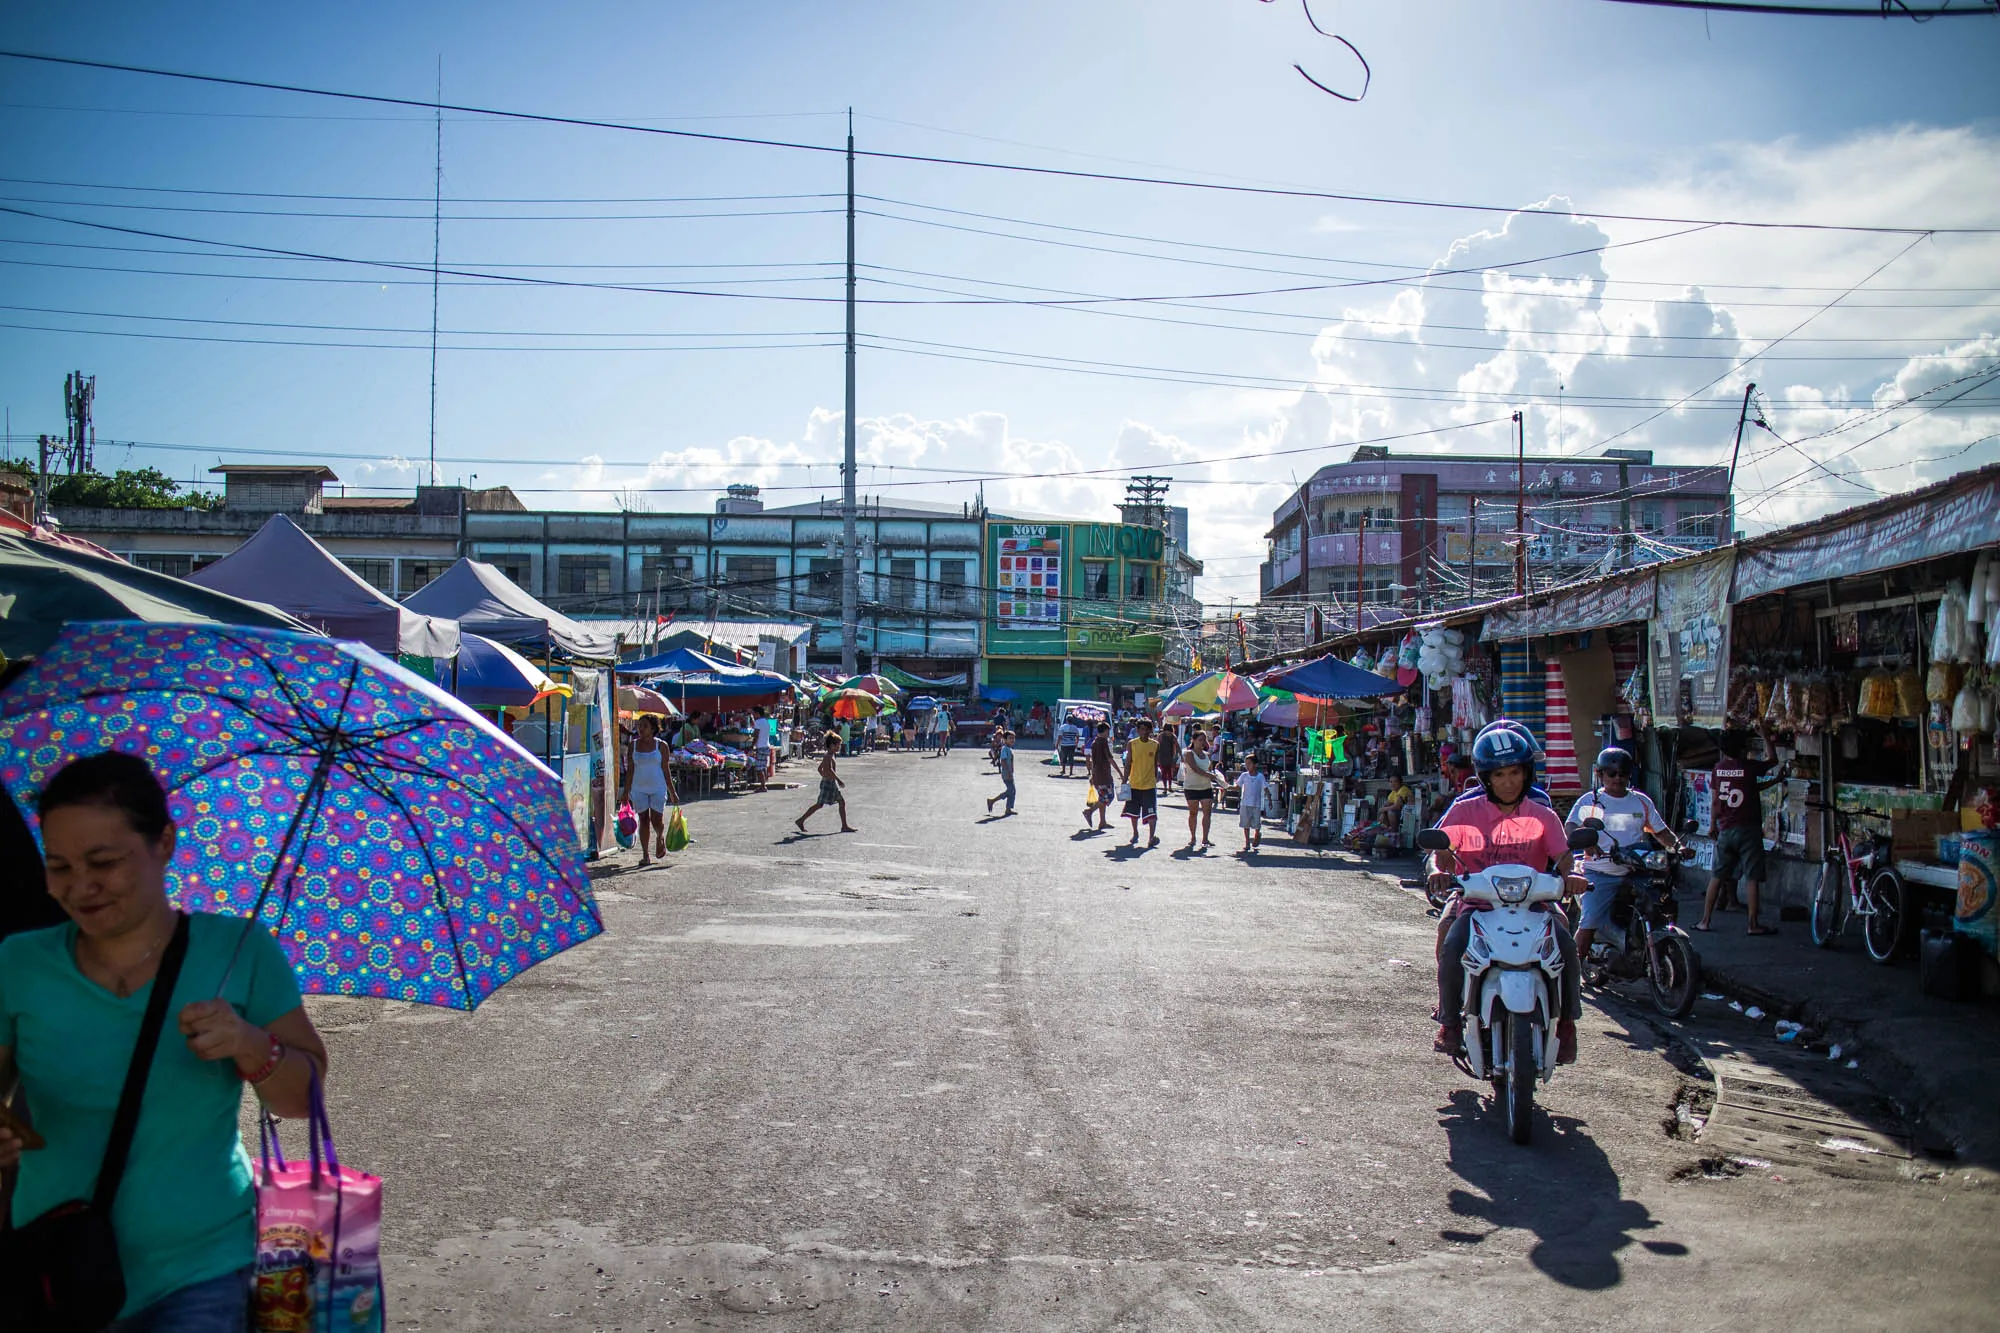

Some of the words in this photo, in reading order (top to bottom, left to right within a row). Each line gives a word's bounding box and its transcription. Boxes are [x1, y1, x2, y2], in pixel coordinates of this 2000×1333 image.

[1012, 525, 1046, 536] NOVO
[1089, 522, 1163, 560] NOVO
[1719, 781, 1744, 808] 50
[265, 1206, 295, 1220] cherry
